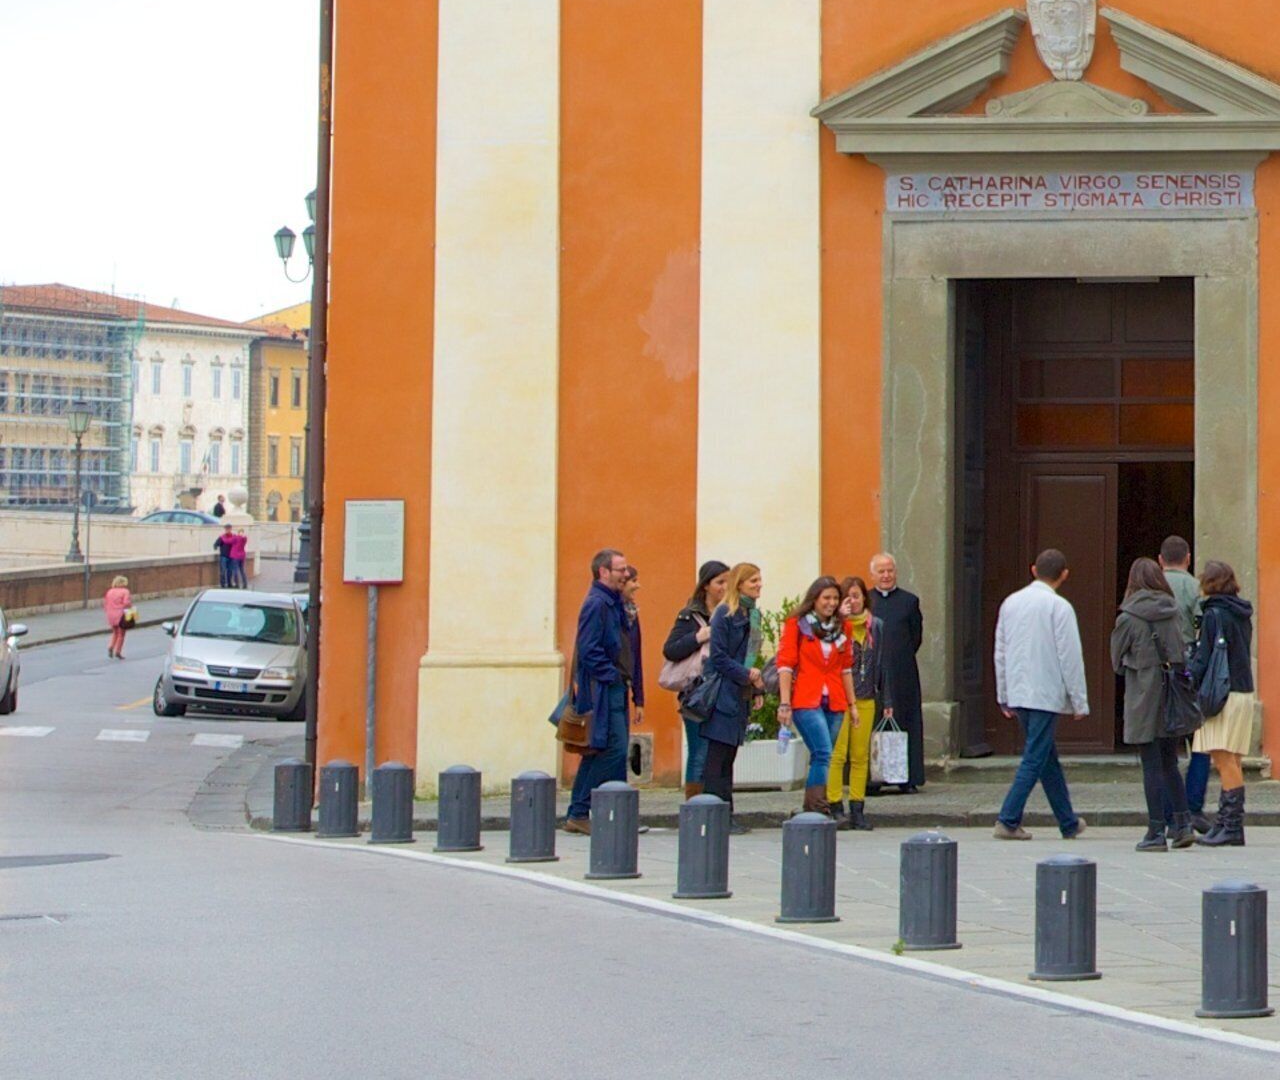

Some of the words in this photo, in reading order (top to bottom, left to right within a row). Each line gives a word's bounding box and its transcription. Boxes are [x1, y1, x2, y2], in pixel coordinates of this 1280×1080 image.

[899, 175, 919, 191] S.
[928, 175, 1048, 191] CATHARINA
[1059, 174, 1121, 190] VIRGO
[1136, 173, 1242, 190] SENENSIS
[897, 193, 930, 208] HIC
[944, 193, 1032, 208] RECEPIT
[1043, 192, 1144, 208] STIGMATA
[1159, 191, 1242, 206] CHRISTI
